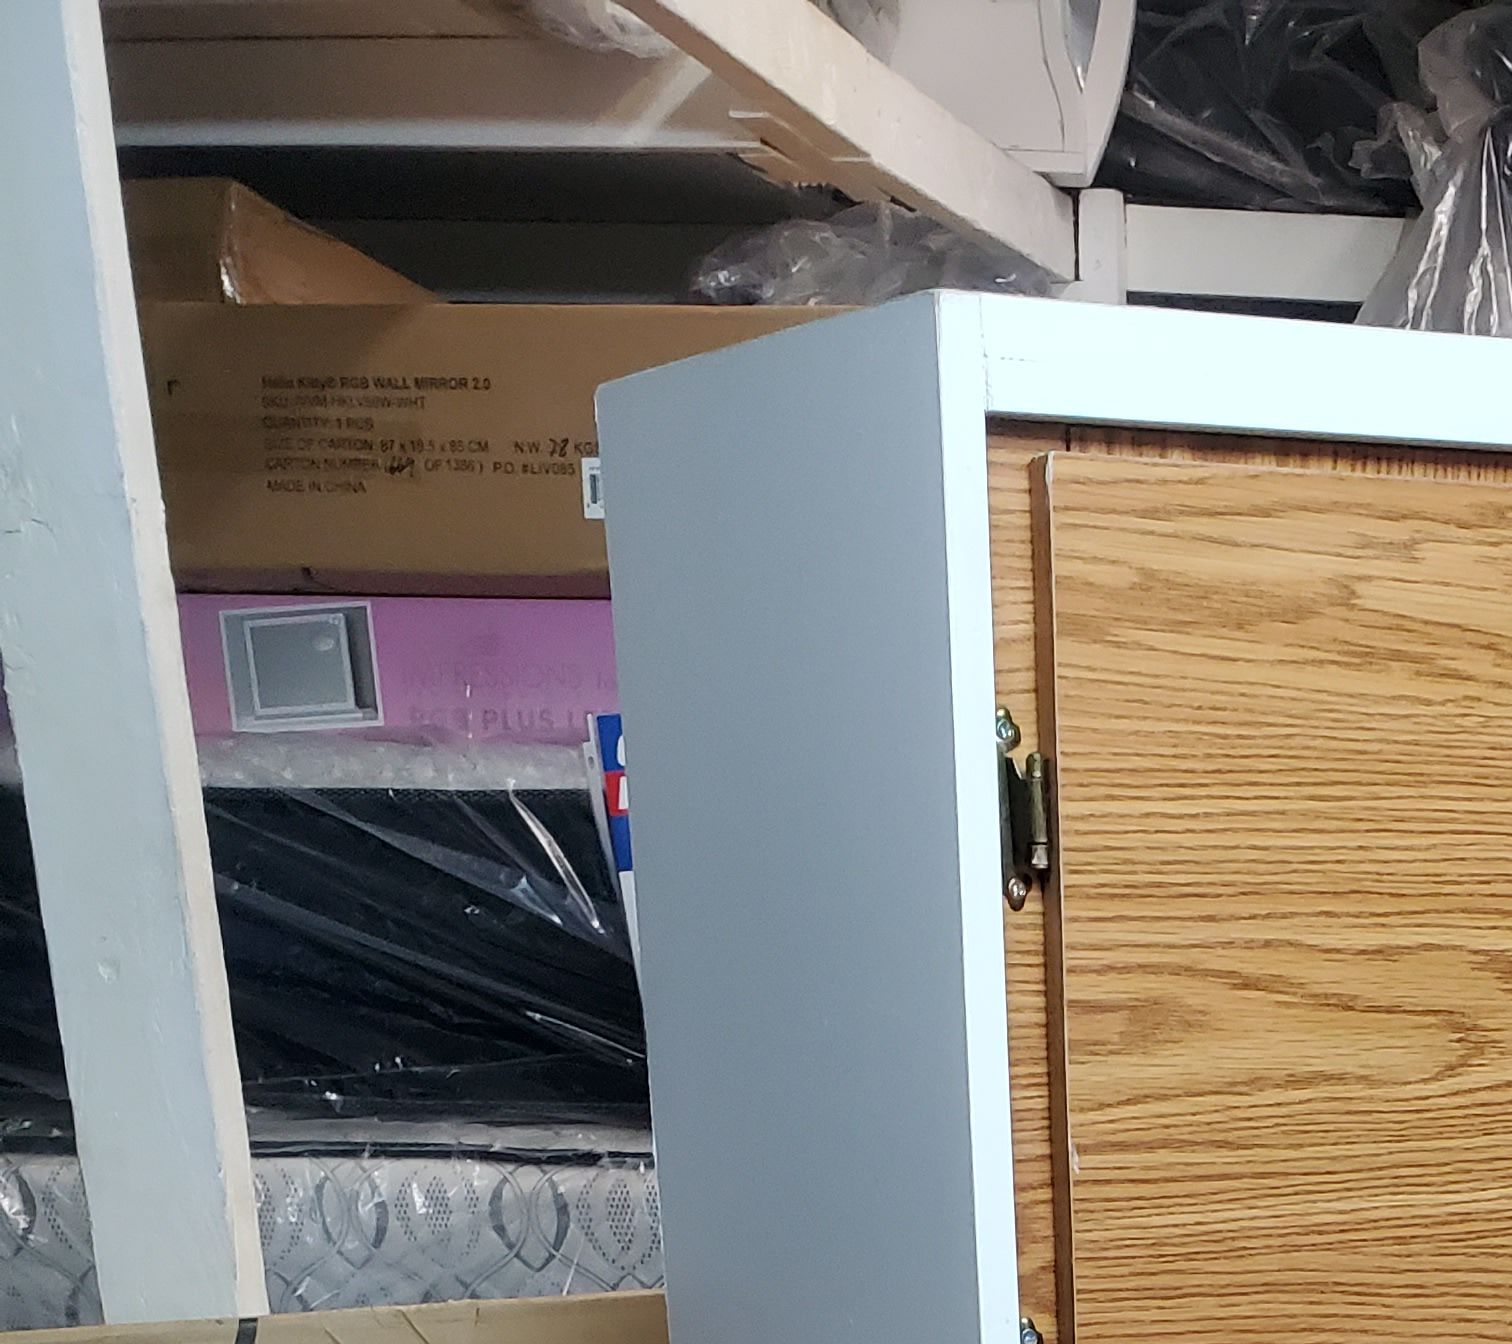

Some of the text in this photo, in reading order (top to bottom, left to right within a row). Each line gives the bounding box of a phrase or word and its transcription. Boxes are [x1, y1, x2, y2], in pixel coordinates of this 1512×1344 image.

[339, 376, 369, 389] RGB
[373, 376, 411, 390] WALL
[414, 377, 468, 390] MIRROR
[472, 377, 491, 390] 2.0
[336, 417, 342, 429] 1
[468, 440, 489, 453] CM
[424, 459, 441, 472] OF
[266, 480, 305, 493] MADE
[309, 480, 322, 493] IN
[481, 707, 555, 732] PLUS
